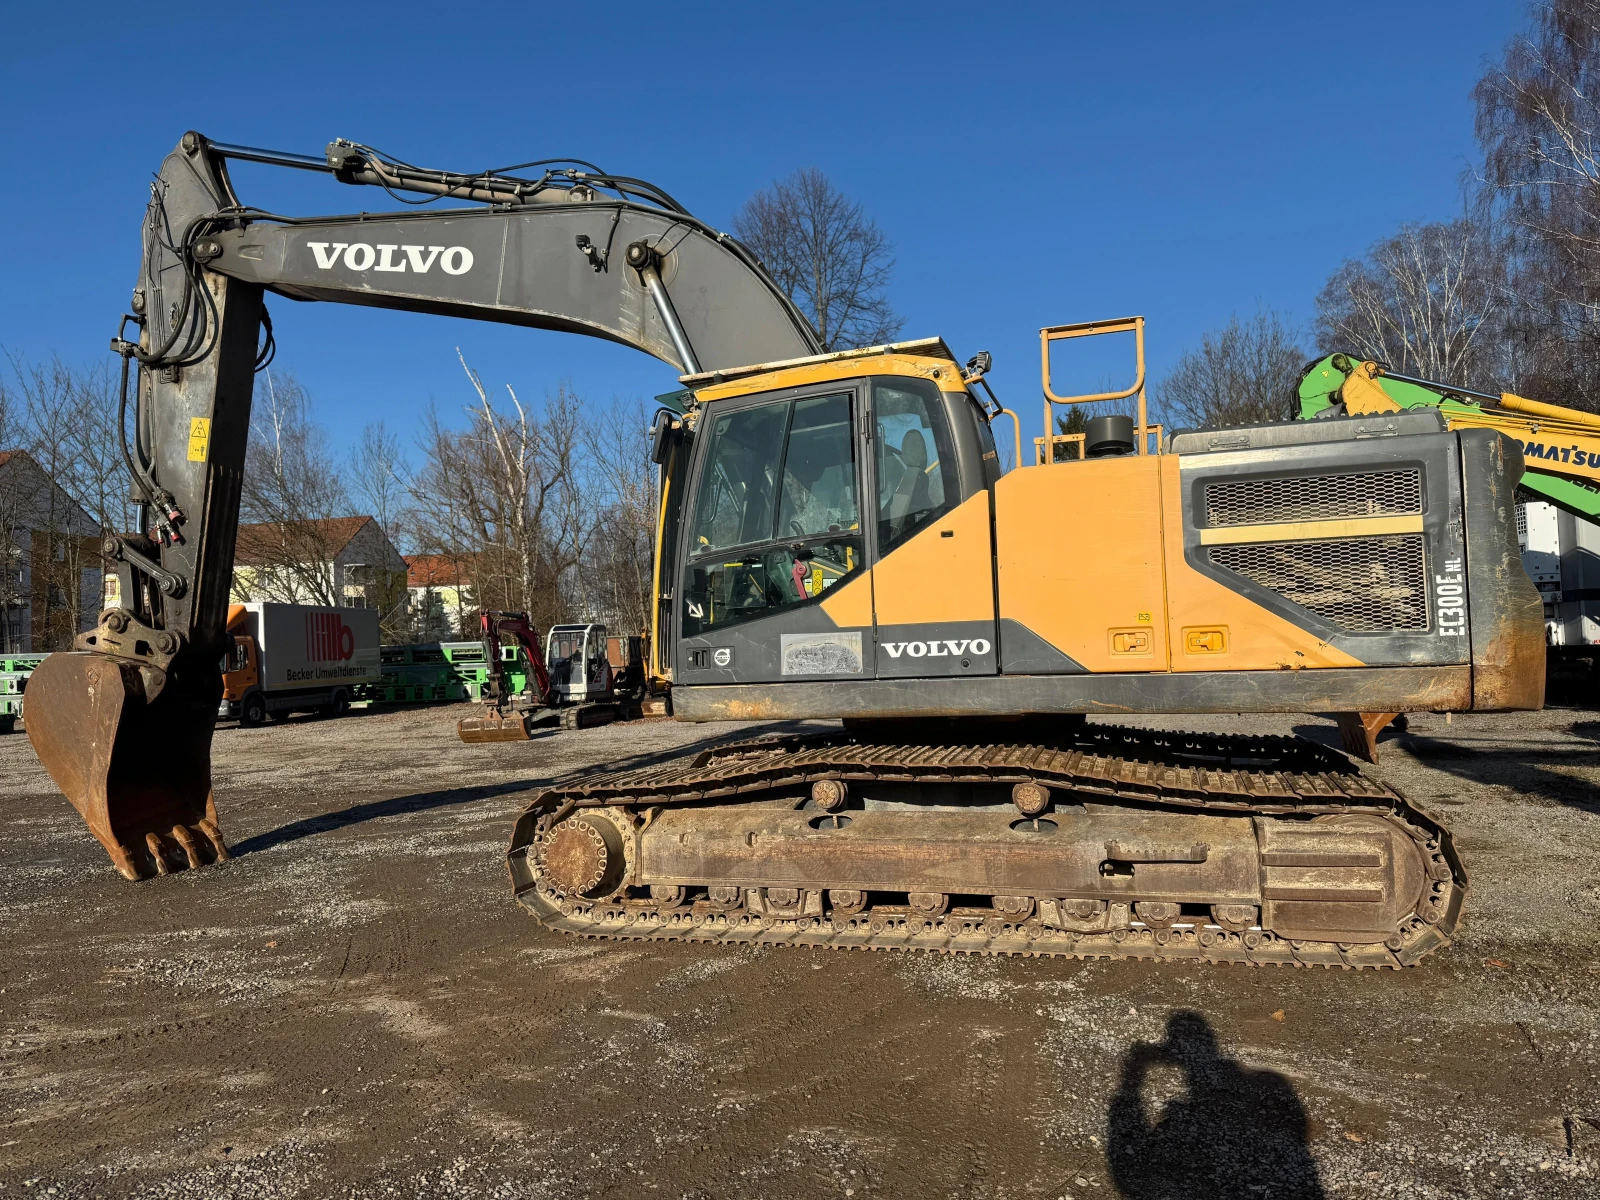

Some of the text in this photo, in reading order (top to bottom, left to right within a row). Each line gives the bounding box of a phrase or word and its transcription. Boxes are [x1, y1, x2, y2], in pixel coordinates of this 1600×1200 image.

[307, 242, 474, 275] VOLVO
[881, 639, 991, 658] VOLVO
[287, 665, 367, 681] Becker Umweltdienste
